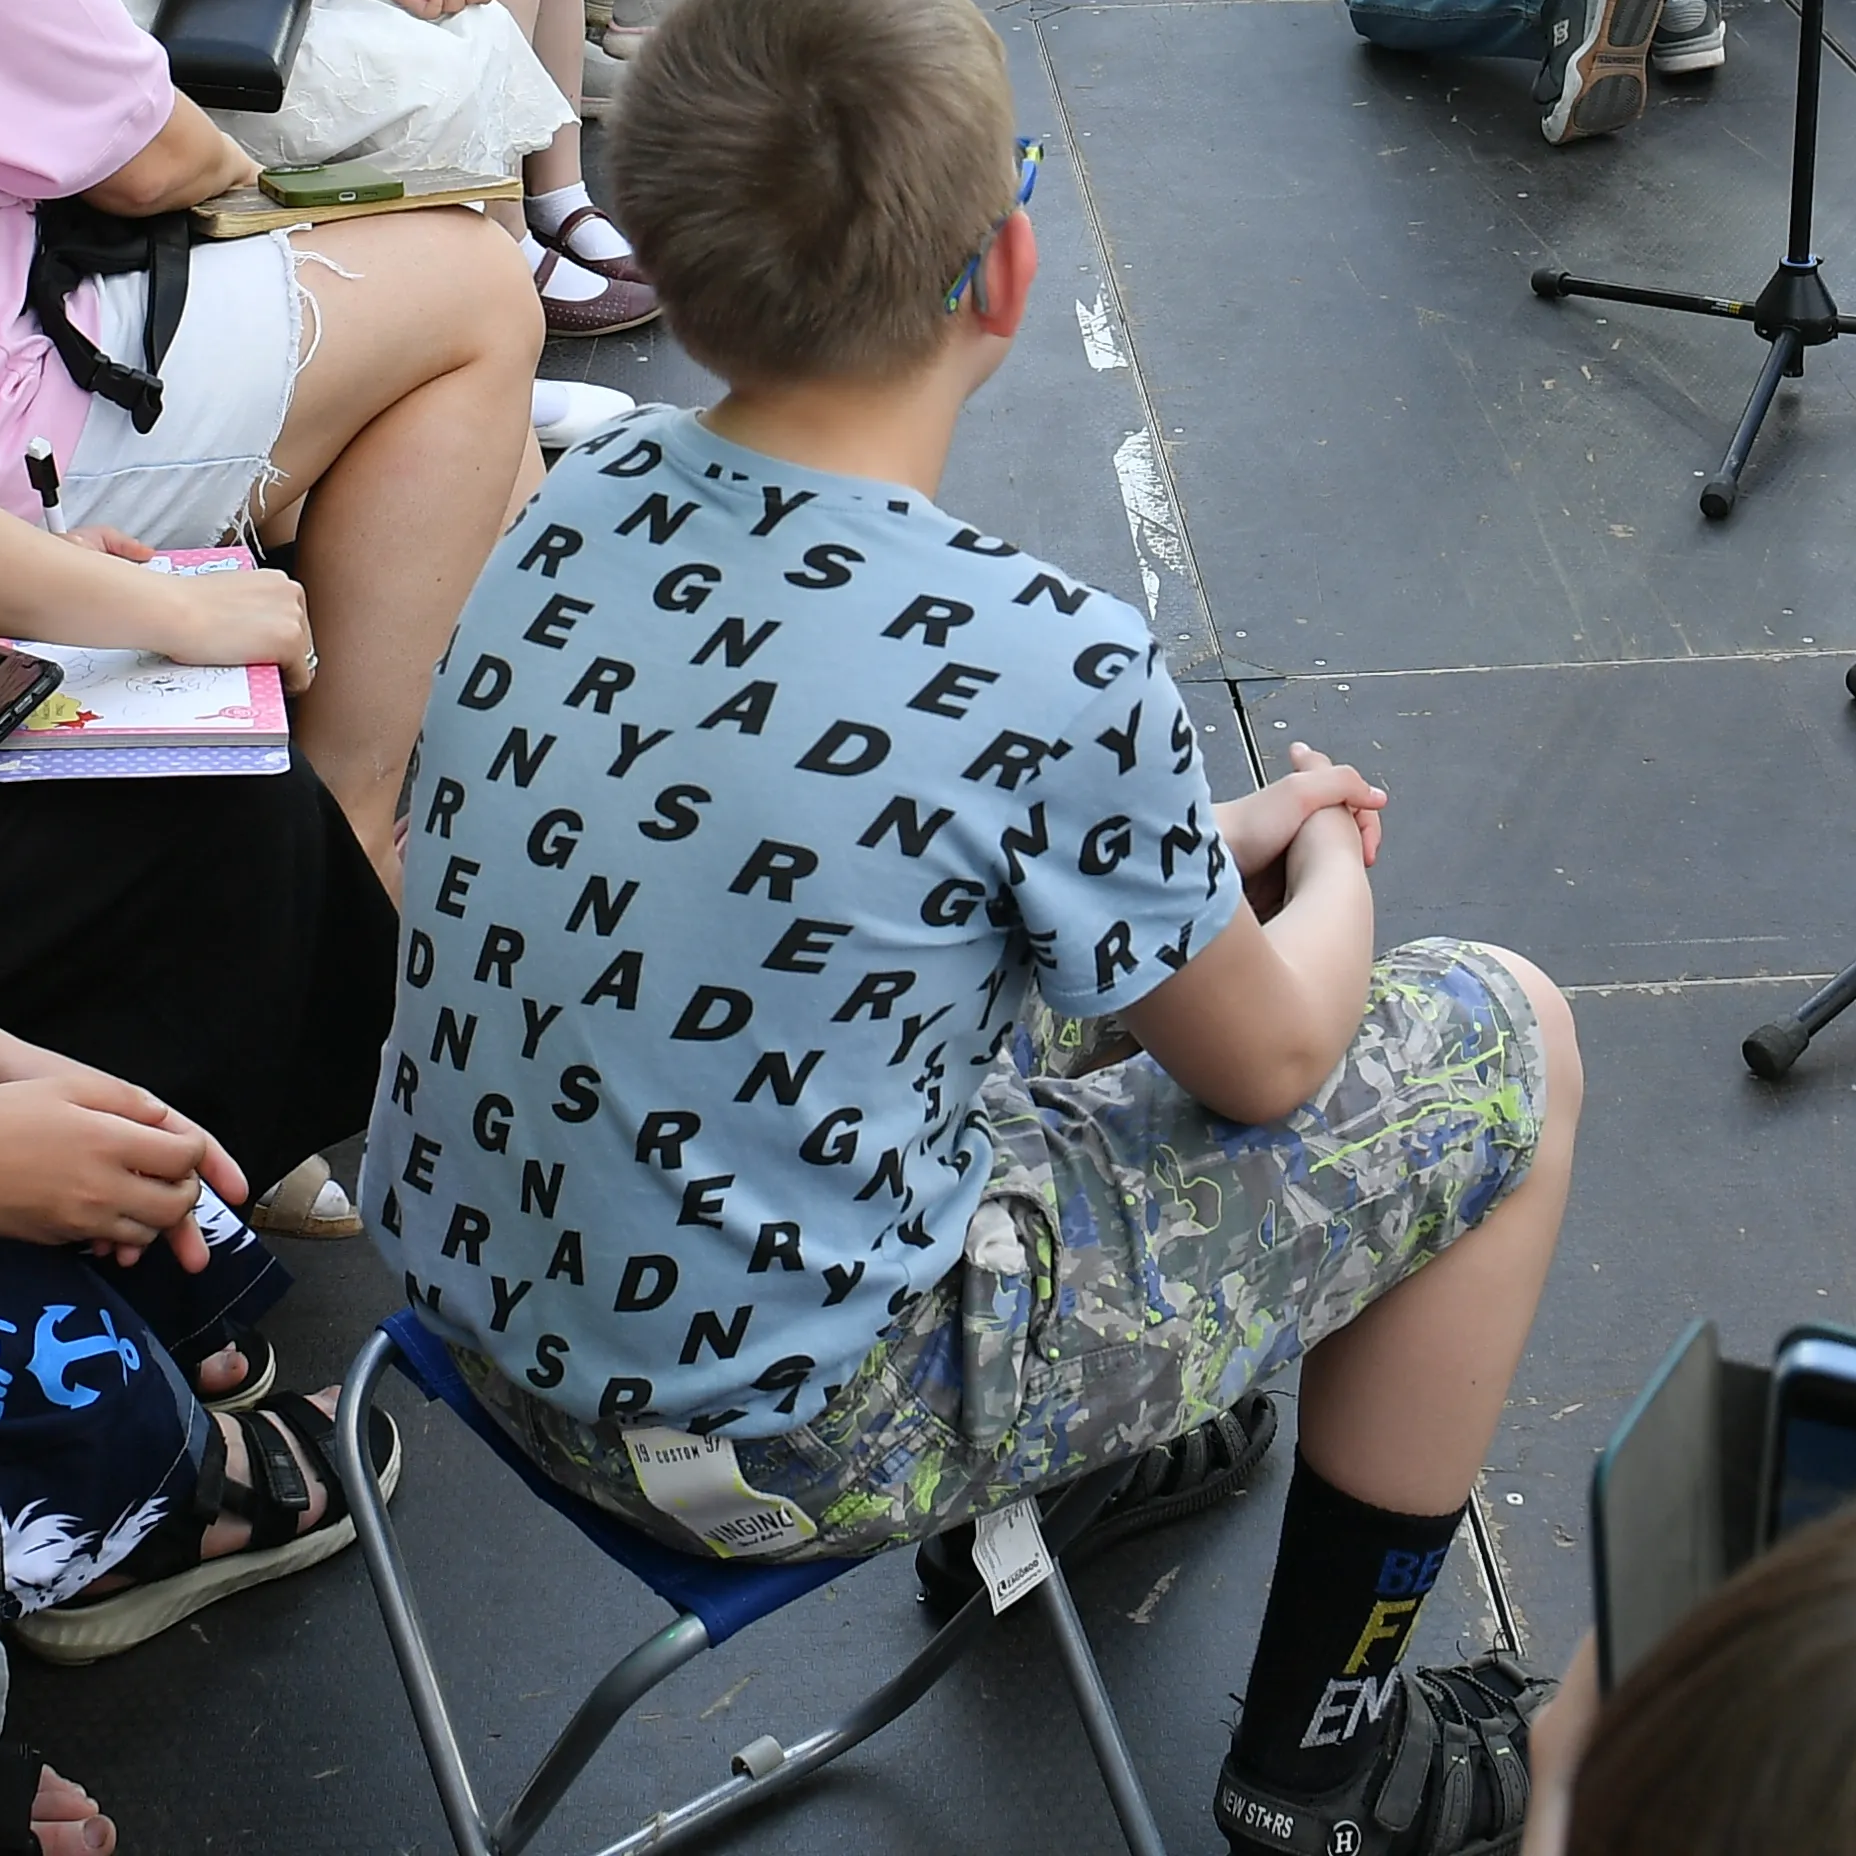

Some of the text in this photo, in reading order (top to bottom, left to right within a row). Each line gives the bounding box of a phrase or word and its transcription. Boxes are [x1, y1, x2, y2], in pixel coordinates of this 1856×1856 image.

[600, 440, 662, 477] D
[615, 493, 700, 544] N
[518, 524, 583, 578] R
[654, 564, 721, 613] G
[523, 594, 593, 649] E
[690, 618, 780, 667] N
[750, 487, 1047, 791] Y S R E R
[1014, 574, 1082, 614] N
[1074, 644, 1138, 688] G
[458, 654, 511, 710] D
[564, 657, 635, 714] R
[697, 681, 777, 735] A
[487, 727, 556, 788] N
[607, 724, 673, 778] Y
[795, 721, 890, 776] D
[425, 777, 464, 839] R
[639, 785, 711, 841] S
[857, 796, 954, 857] N
[527, 809, 583, 869] G
[1078, 815, 1131, 876] G
[435, 856, 480, 919] E
[728, 840, 818, 903] R
[565, 876, 640, 936] N
[921, 878, 986, 927] G
[474, 924, 524, 989] R
[761, 918, 853, 974] E
[1095, 921, 1138, 994] R
[581, 950, 643, 1010] A
[831, 971, 915, 1022] R
[521, 998, 563, 1060] Y
[670, 985, 753, 1041] D
[391, 1051, 418, 1116] R
[552, 1065, 601, 1123] S
[733, 1051, 824, 1106] N
[402, 1132, 442, 1195] E
[406, 928, 434, 989] D
[430, 1006, 478, 1071] N
[473, 1093, 514, 1155] G
[520, 1160, 565, 1220] N
[545, 1230, 584, 1286] A
[613, 1255, 678, 1312] D
[678, 1305, 753, 1365] N
[635, 1111, 701, 1170] R
[799, 1108, 862, 1166] G
[677, 1174, 736, 1228] E
[441, 1203, 490, 1267] R
[747, 1222, 805, 1273] R
[489, 1275, 533, 1333] Y
[526, 1334, 570, 1389] S
[656, 1446, 701, 1464] CUSTOM
